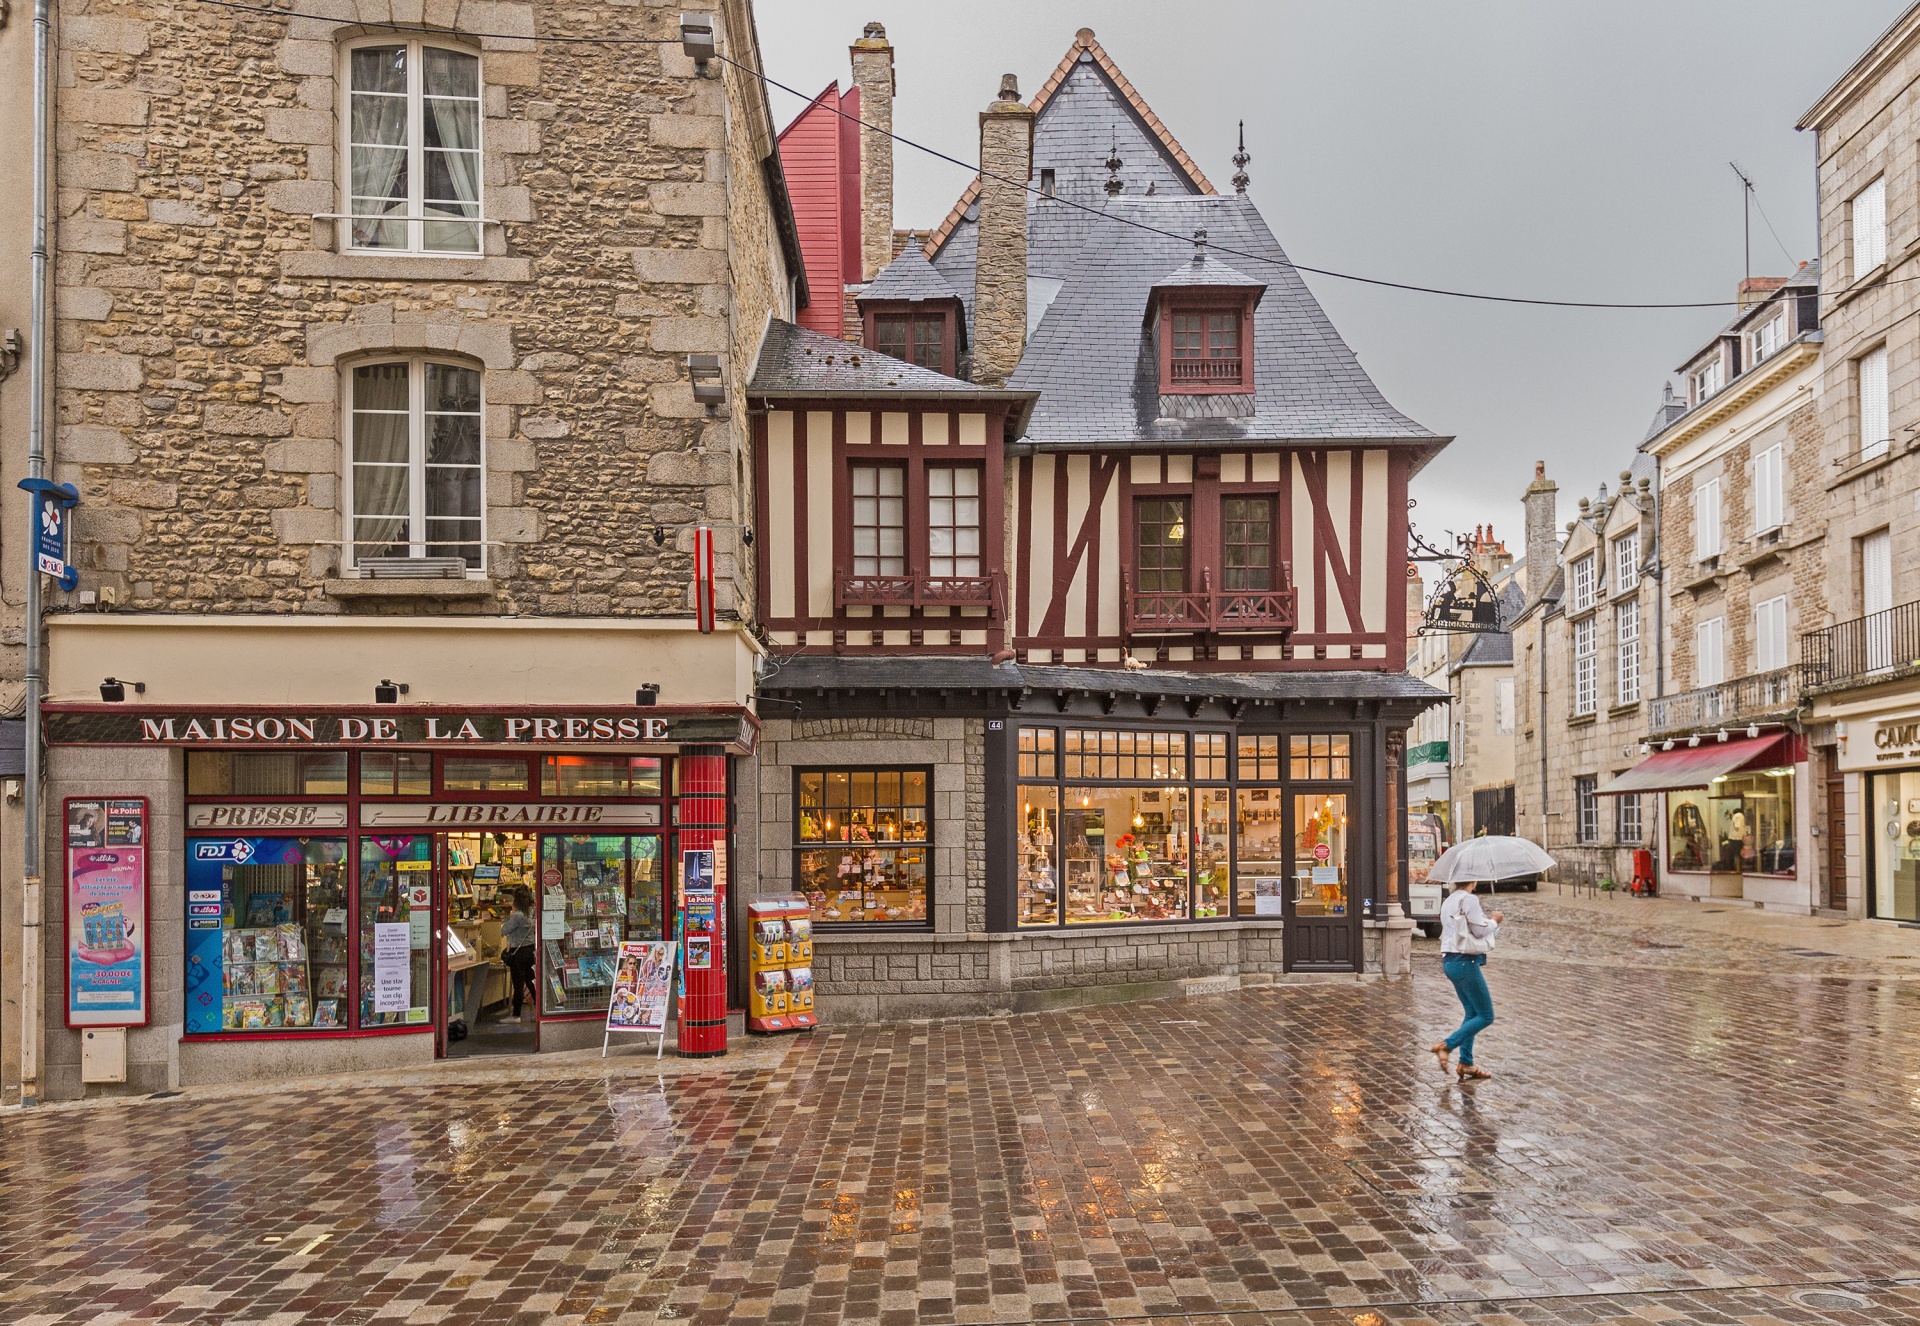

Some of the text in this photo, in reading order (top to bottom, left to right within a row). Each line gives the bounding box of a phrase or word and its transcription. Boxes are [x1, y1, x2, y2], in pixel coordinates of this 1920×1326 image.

[41, 557, 63, 574] LOTO
[140, 718, 669, 741] MAISON DE LA PRESSE
[209, 807, 317, 825] PRESSE
[423, 805, 603, 823] LIBRAIRIE
[199, 846, 227, 857] FDJ
[80, 903, 124, 916] VACANCES
